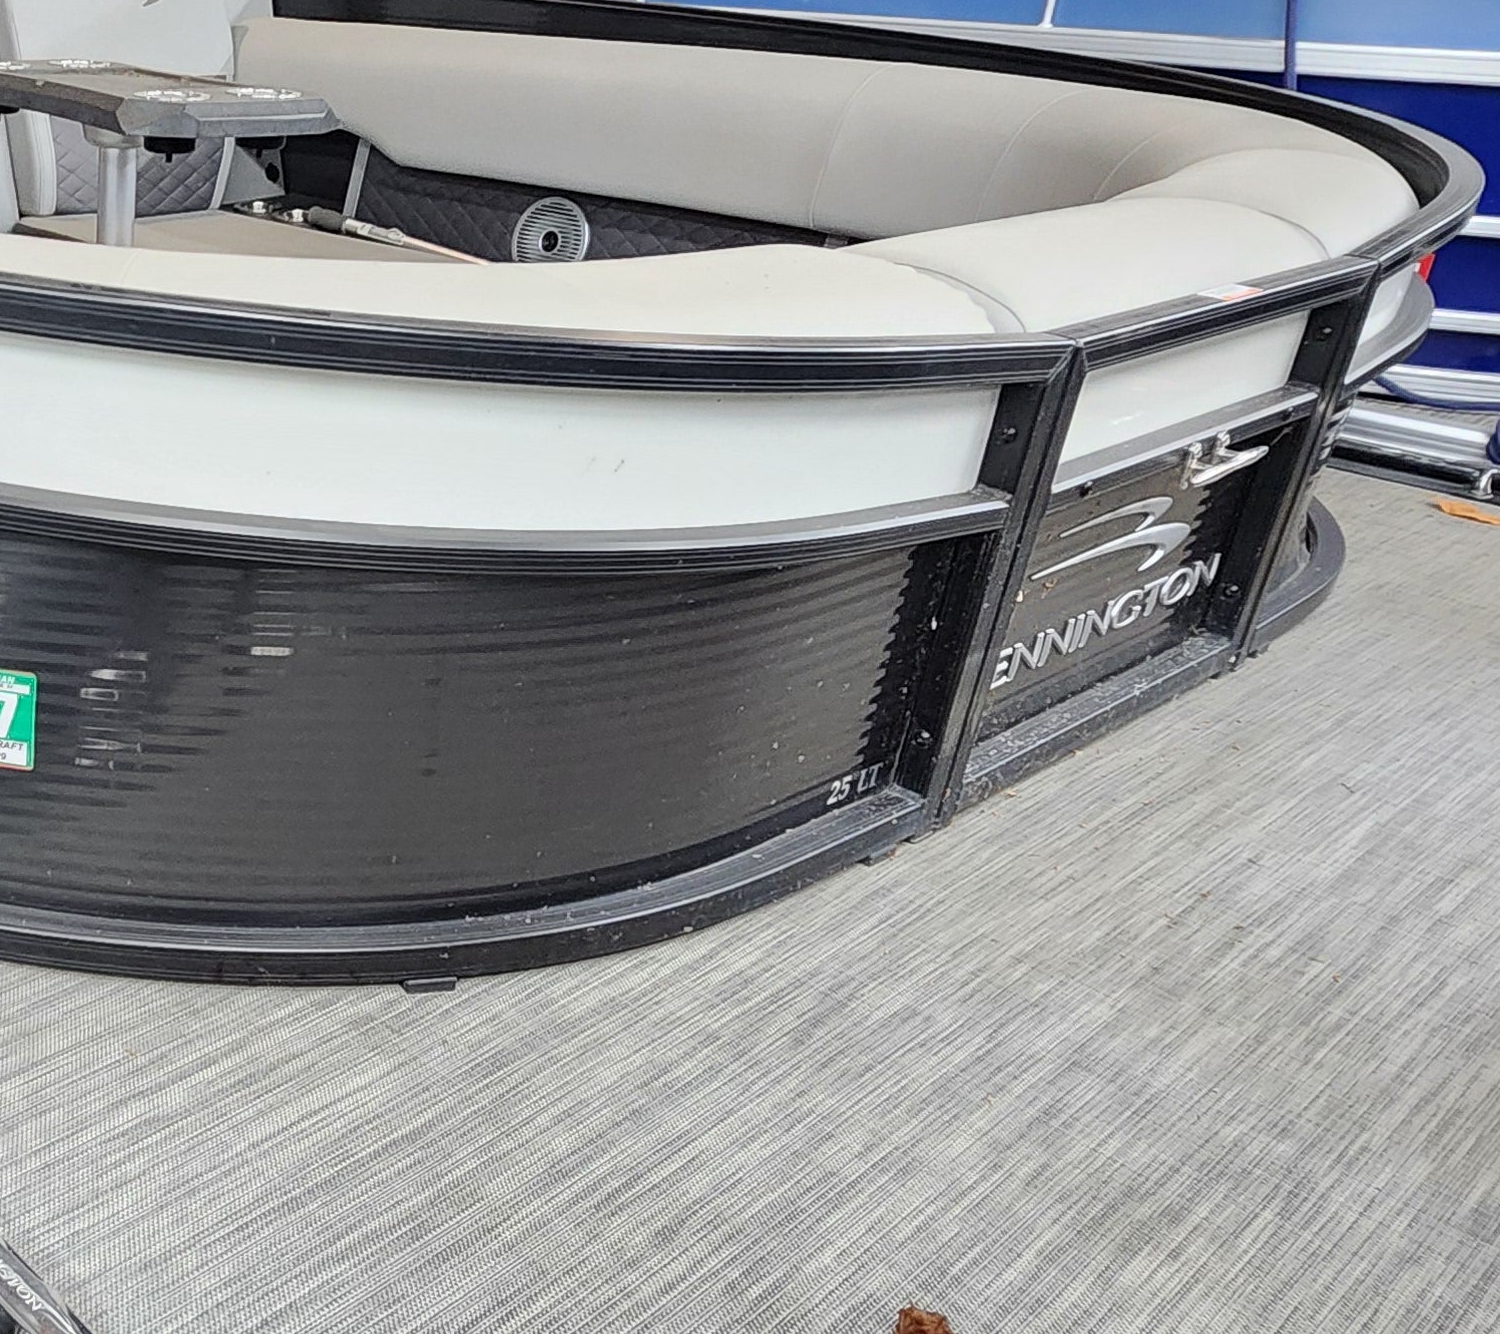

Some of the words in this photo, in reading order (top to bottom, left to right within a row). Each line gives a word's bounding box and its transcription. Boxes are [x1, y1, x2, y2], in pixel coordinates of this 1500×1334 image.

[989, 553, 1221, 690] ENNINGTON
[826, 774, 853, 805] 25
[857, 762, 884, 794] LT
